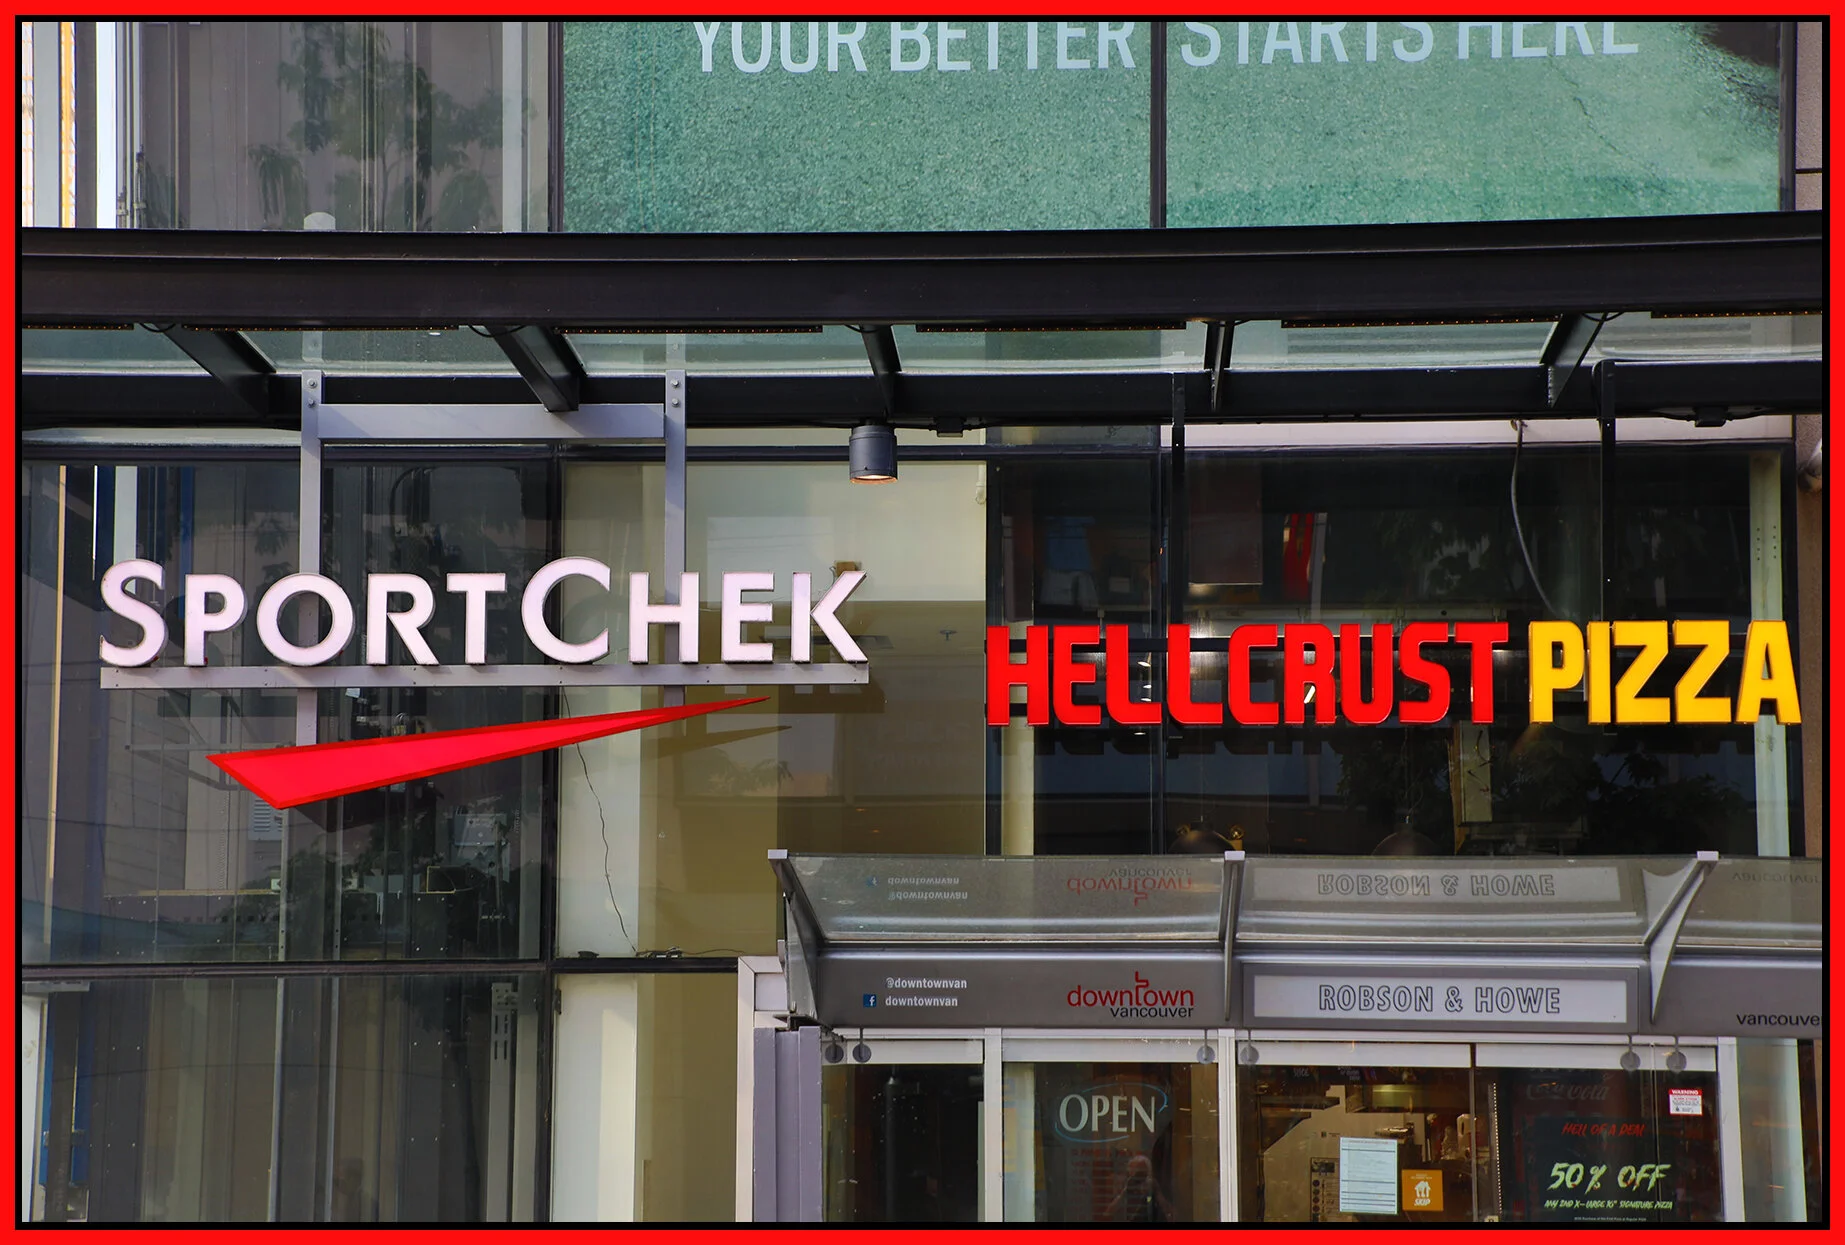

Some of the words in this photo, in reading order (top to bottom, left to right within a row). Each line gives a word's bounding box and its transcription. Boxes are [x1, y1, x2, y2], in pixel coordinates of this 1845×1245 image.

[694, 22, 867, 73] YOUR
[986, 623, 1509, 726] HELLCRUST
[1528, 620, 1802, 725] PIZZA
[885, 977, 967, 989] @downtownvan
[1067, 971, 1194, 1007] downtown
[885, 995, 958, 1007] downtownvan
[1110, 1007, 1194, 1018] vancouver
[1319, 984, 1433, 1012] ROBSON
[1445, 986, 1463, 1012] &
[1475, 987, 1560, 1013] HOWE
[1059, 1094, 1155, 1133] OPEN
[1561, 1123, 1587, 1136] HELL
[1617, 1164, 1671, 1192] OFF
